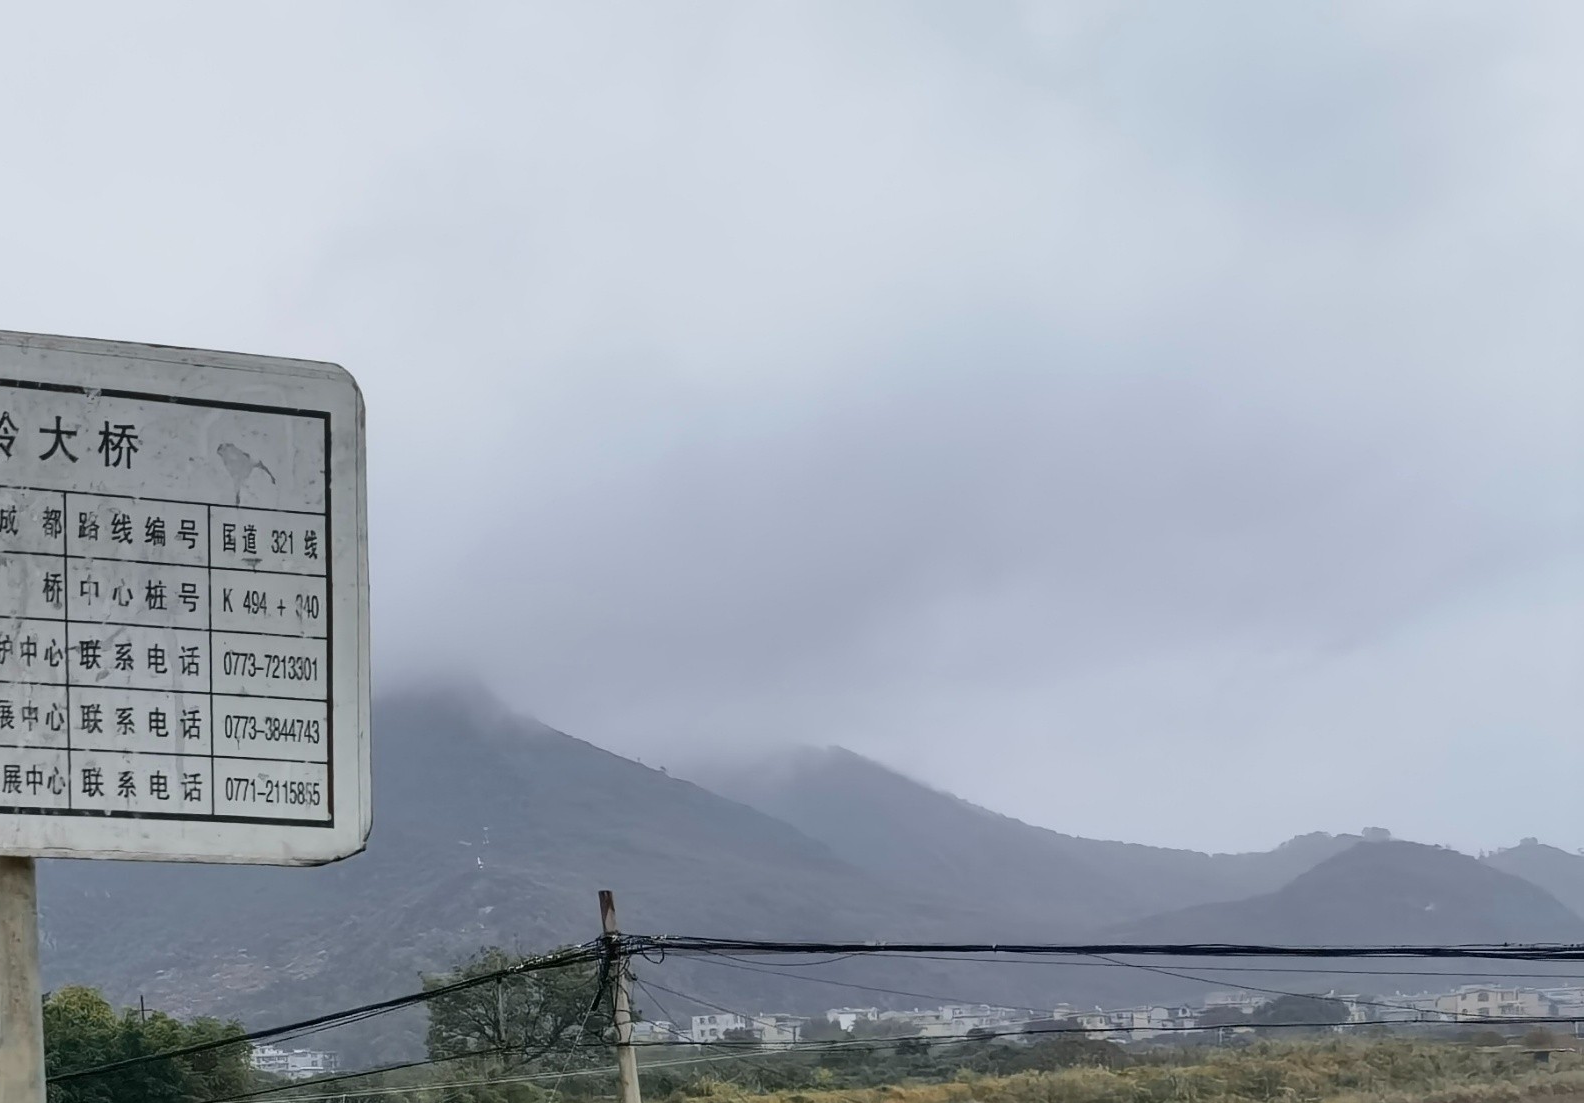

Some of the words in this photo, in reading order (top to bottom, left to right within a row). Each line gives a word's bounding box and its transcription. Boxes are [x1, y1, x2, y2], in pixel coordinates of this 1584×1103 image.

[78, 511, 199, 549] 路线编号
[222, 523, 257, 555] 国道
[271, 530, 294, 555] 321
[79, 574, 200, 613] 中心桩号
[79, 640, 201, 677] 联系电话
[223, 651, 319, 681] 0773-7213301
[80, 704, 202, 740] 联系电话
[224, 715, 320, 744] 0773-3844743
[81, 767, 203, 802] 联系电话
[225, 778, 321, 806] 0771-2115855
